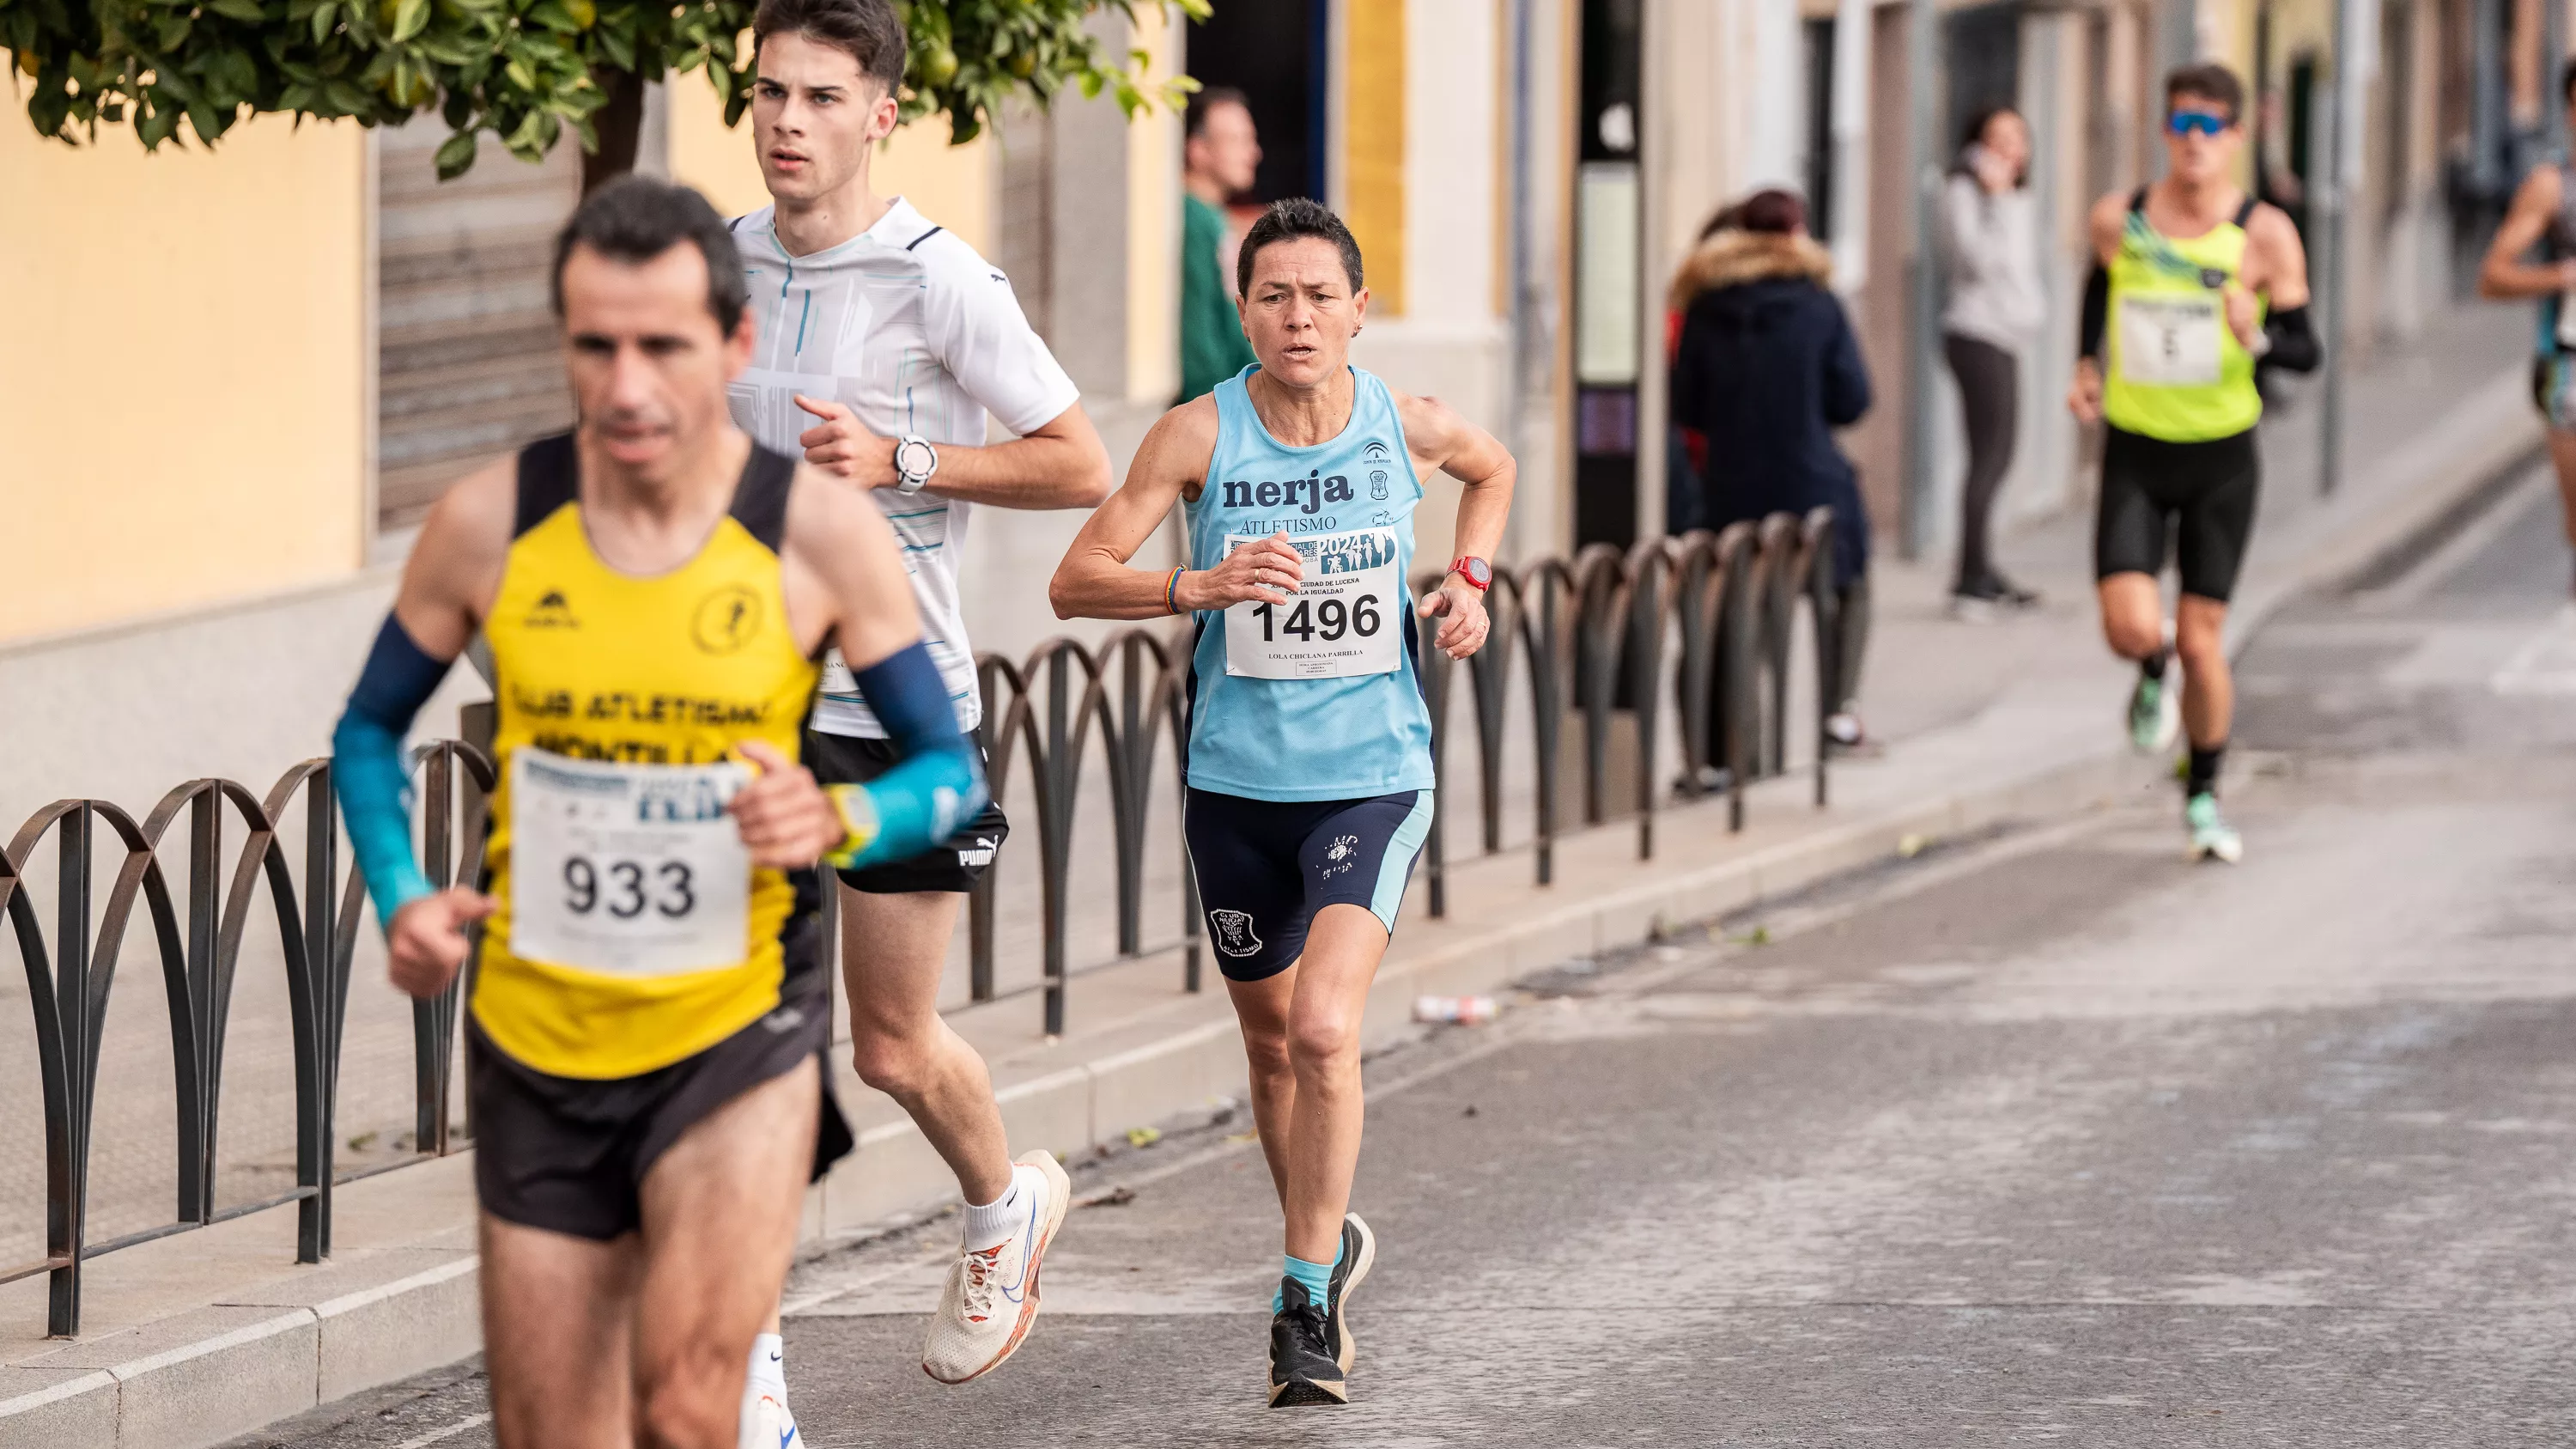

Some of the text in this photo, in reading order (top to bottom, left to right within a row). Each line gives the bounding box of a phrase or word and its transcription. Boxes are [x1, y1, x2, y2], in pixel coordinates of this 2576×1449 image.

[1223, 469, 1354, 514] nerja
[1239, 515, 1336, 534] ATLETISMO
[1320, 536, 1363, 557] 2024
[1335, 577, 1359, 586] LUCENA
[1252, 594, 1381, 642] 1496
[1327, 649, 1364, 658] PARRILLA
[958, 849, 993, 866] PUMA
[562, 856, 696, 920] 933
